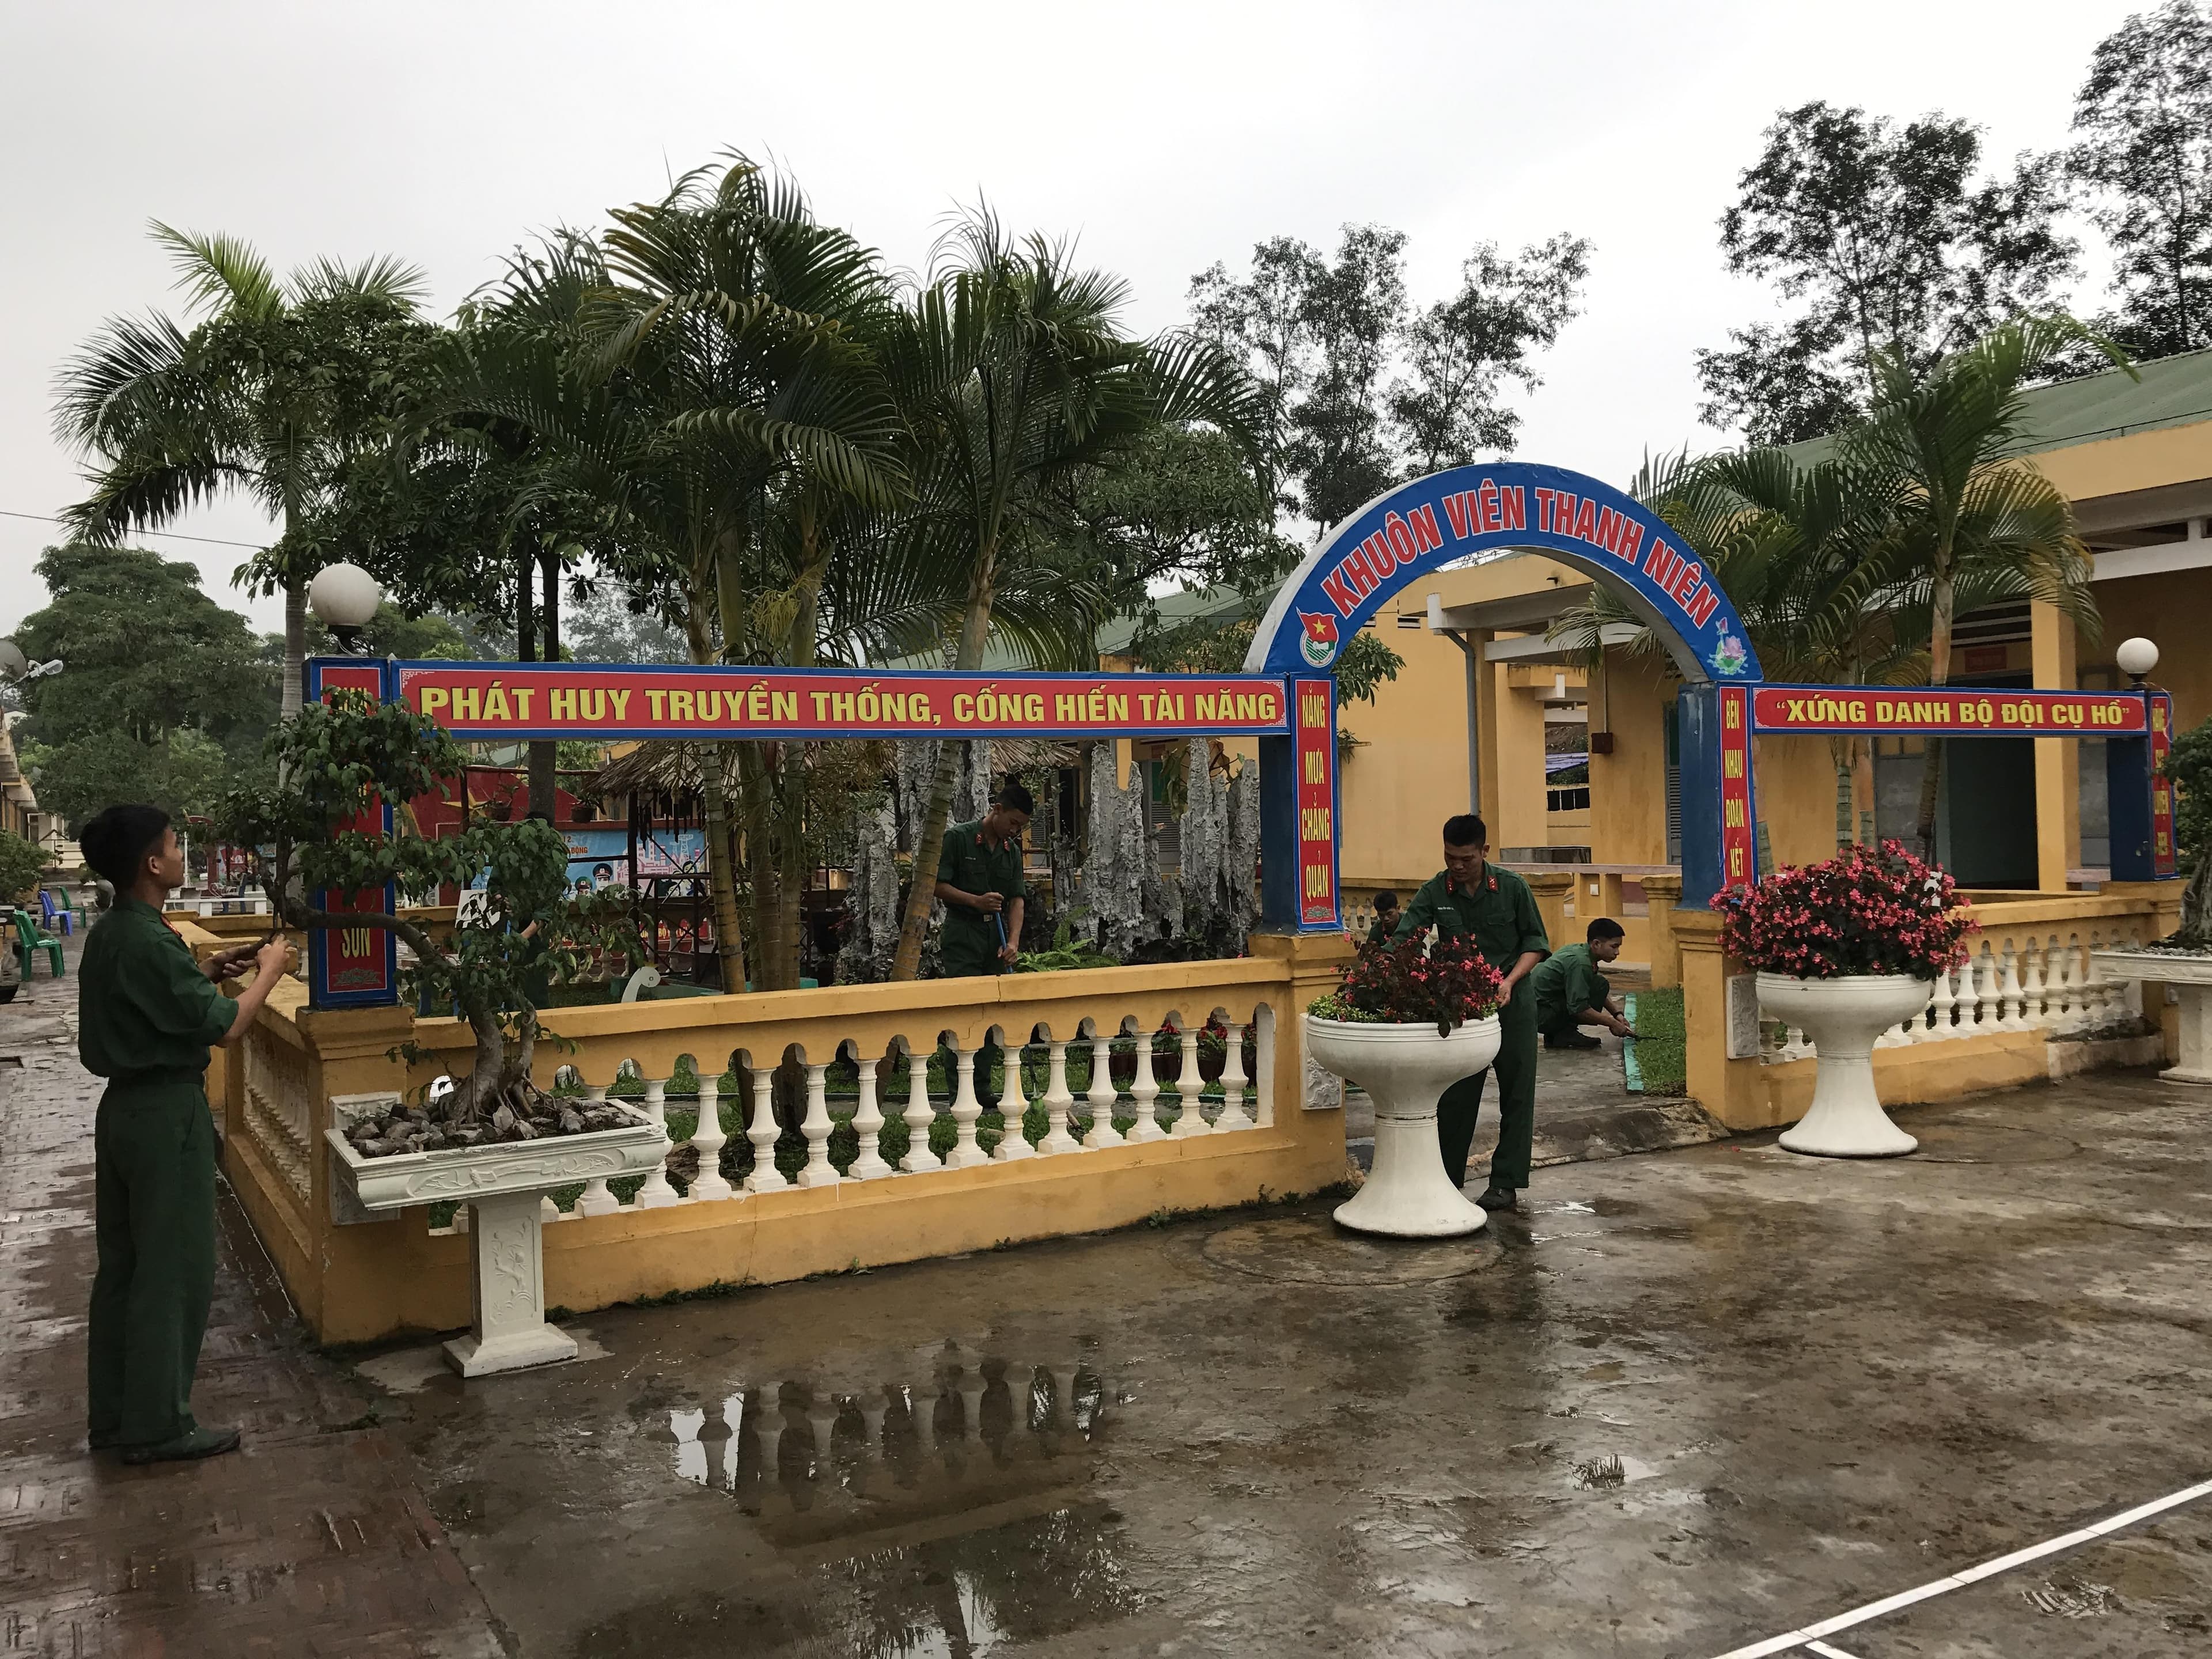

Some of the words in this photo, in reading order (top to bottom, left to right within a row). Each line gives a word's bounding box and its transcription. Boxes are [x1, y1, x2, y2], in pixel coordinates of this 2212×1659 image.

[1320, 502, 1444, 620] KHUÔN
[1441, 478, 1527, 540] VIÊN
[1535, 487, 1645, 566] THANH
[1642, 536, 1720, 630] NIÊN
[421, 681, 535, 720] PHÁT
[551, 689, 631, 721] HUY
[645, 680, 798, 721] TRUYỀN
[810, 682, 941, 725] THỐNG,
[953, 683, 1044, 722] CỐNG
[1055, 684, 1128, 721] HIẾN
[1138, 688, 1185, 721] TÀI
[1195, 688, 1276, 720] NĂNG
[1302, 683, 1325, 728] NẮNG
[1726, 694, 1739, 729] BÊN
[1876, 701, 1950, 723] DANH
[1959, 699, 1994, 727] BỘ
[2001, 699, 2044, 728] ĐỘI
[2051, 704, 2084, 728] CỤ
[1305, 748, 1324, 785] MƯA
[1725, 749, 1743, 779] NHAU
[1302, 791, 1330, 842] CHẲNG
[1726, 792, 1745, 828] ĐOÀN
[1306, 850, 1329, 902] QUẢN
[1730, 837, 1744, 877] KẾT
